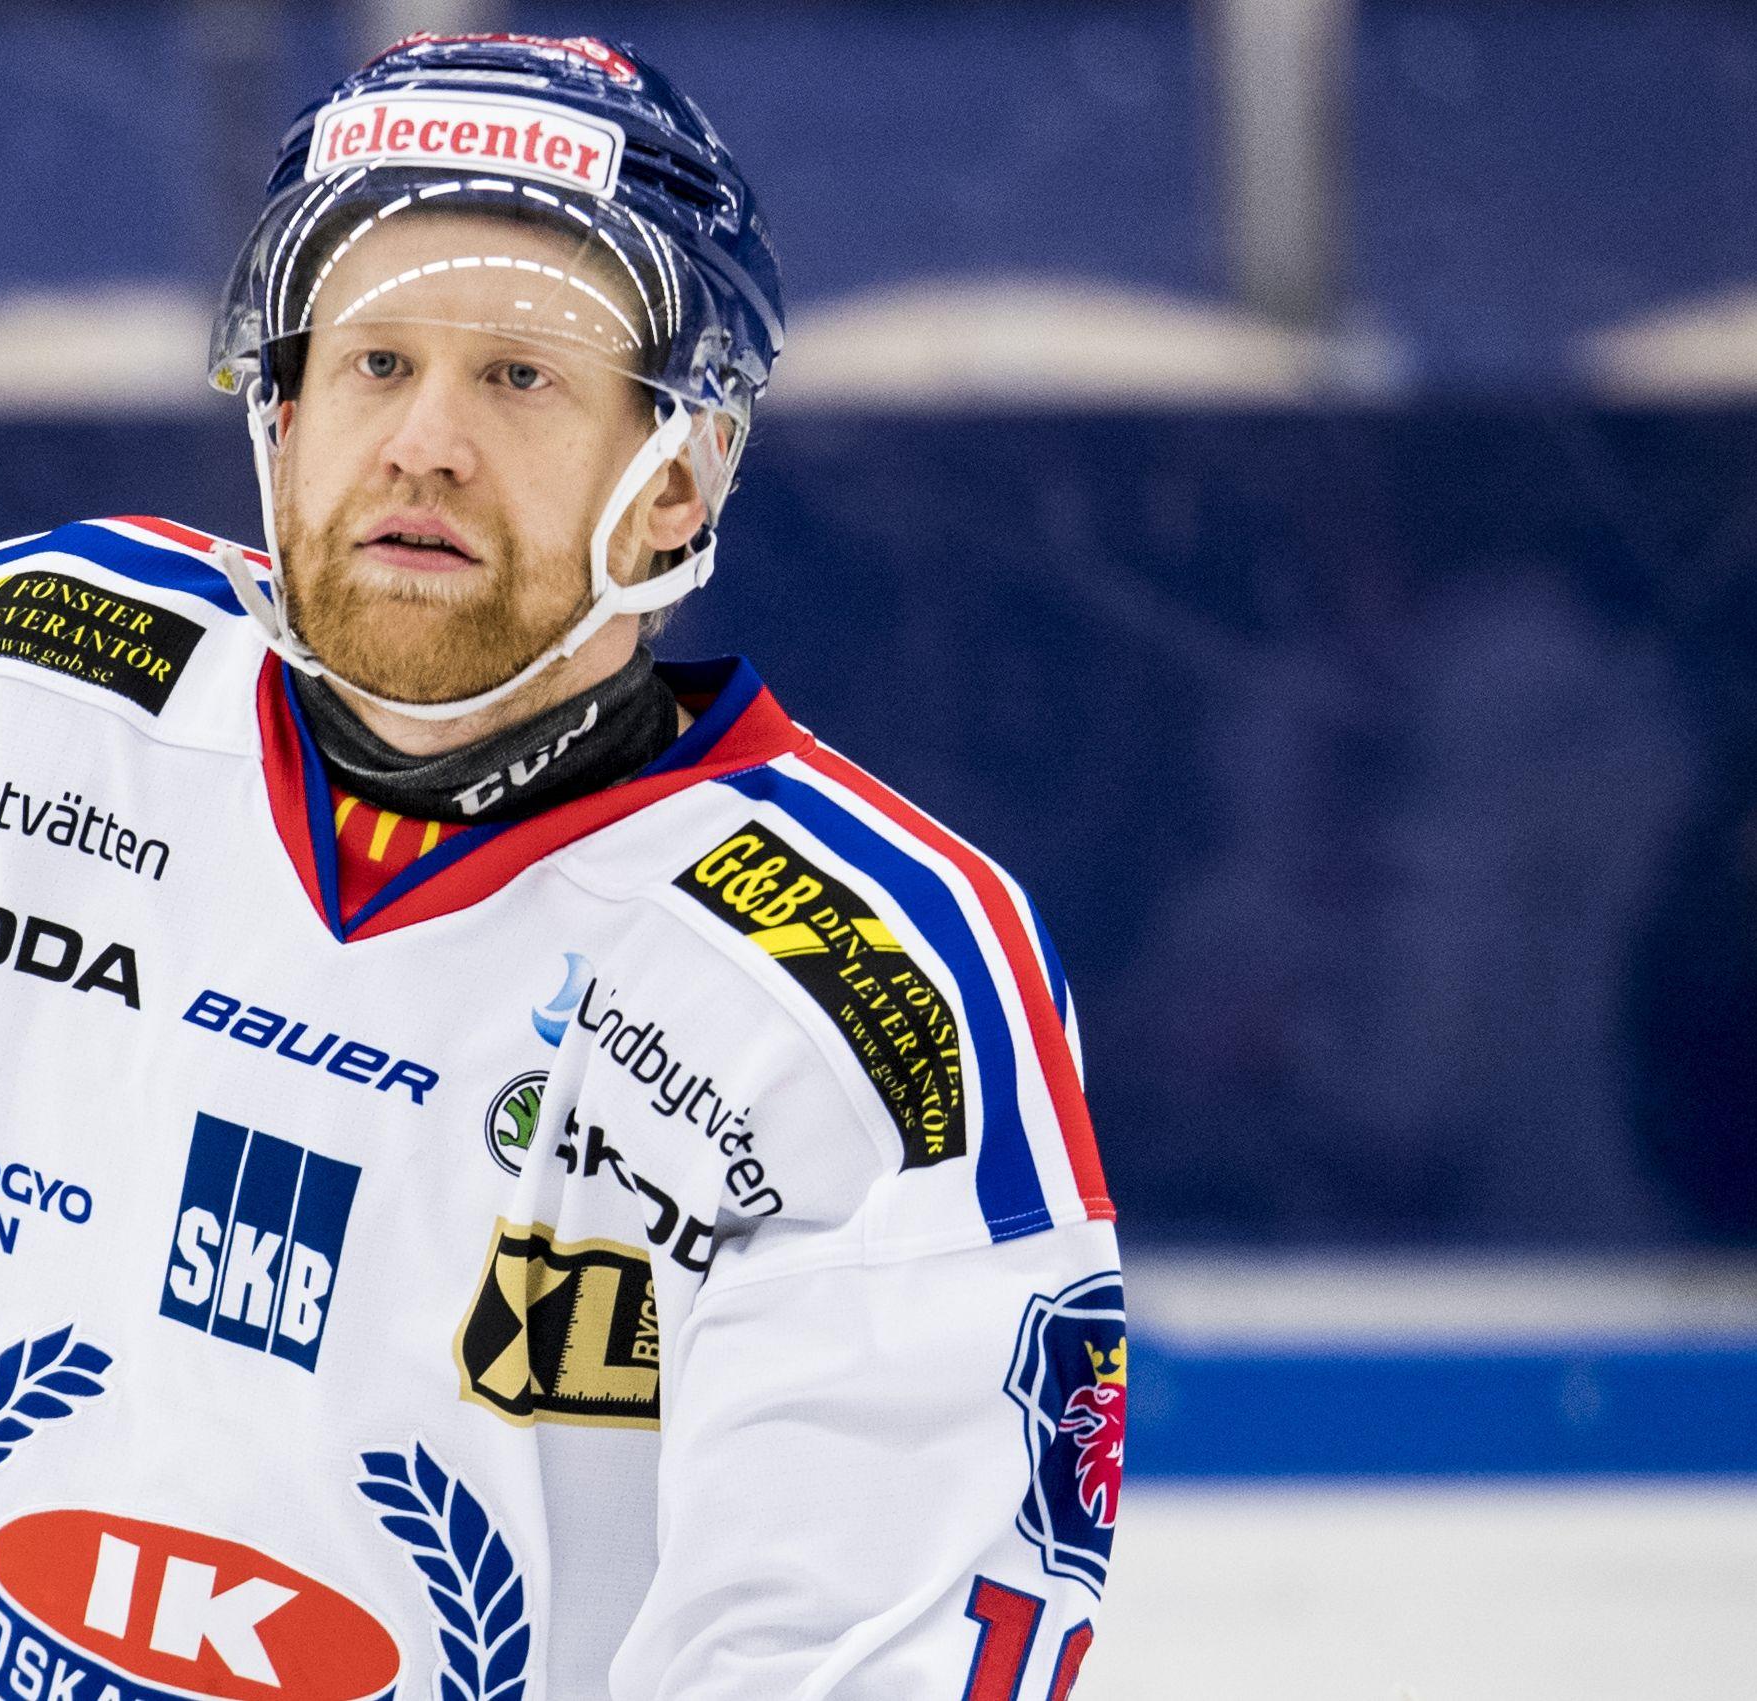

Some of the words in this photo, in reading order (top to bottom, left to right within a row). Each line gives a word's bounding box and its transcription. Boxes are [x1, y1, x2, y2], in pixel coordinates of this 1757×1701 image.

[325, 106, 601, 181] telecenter
[12, 578, 155, 636] FÖNSTER
[694, 834, 824, 928] G&B
[810, 905, 868, 960] DIN
[182, 988, 440, 1106] BAUER
[838, 961, 949, 1155] LEVERANTÖR
[840, 1003, 917, 1130] www.gob.se
[168, 1205, 334, 1346] SKB
[83, 1531, 301, 1689] IK
